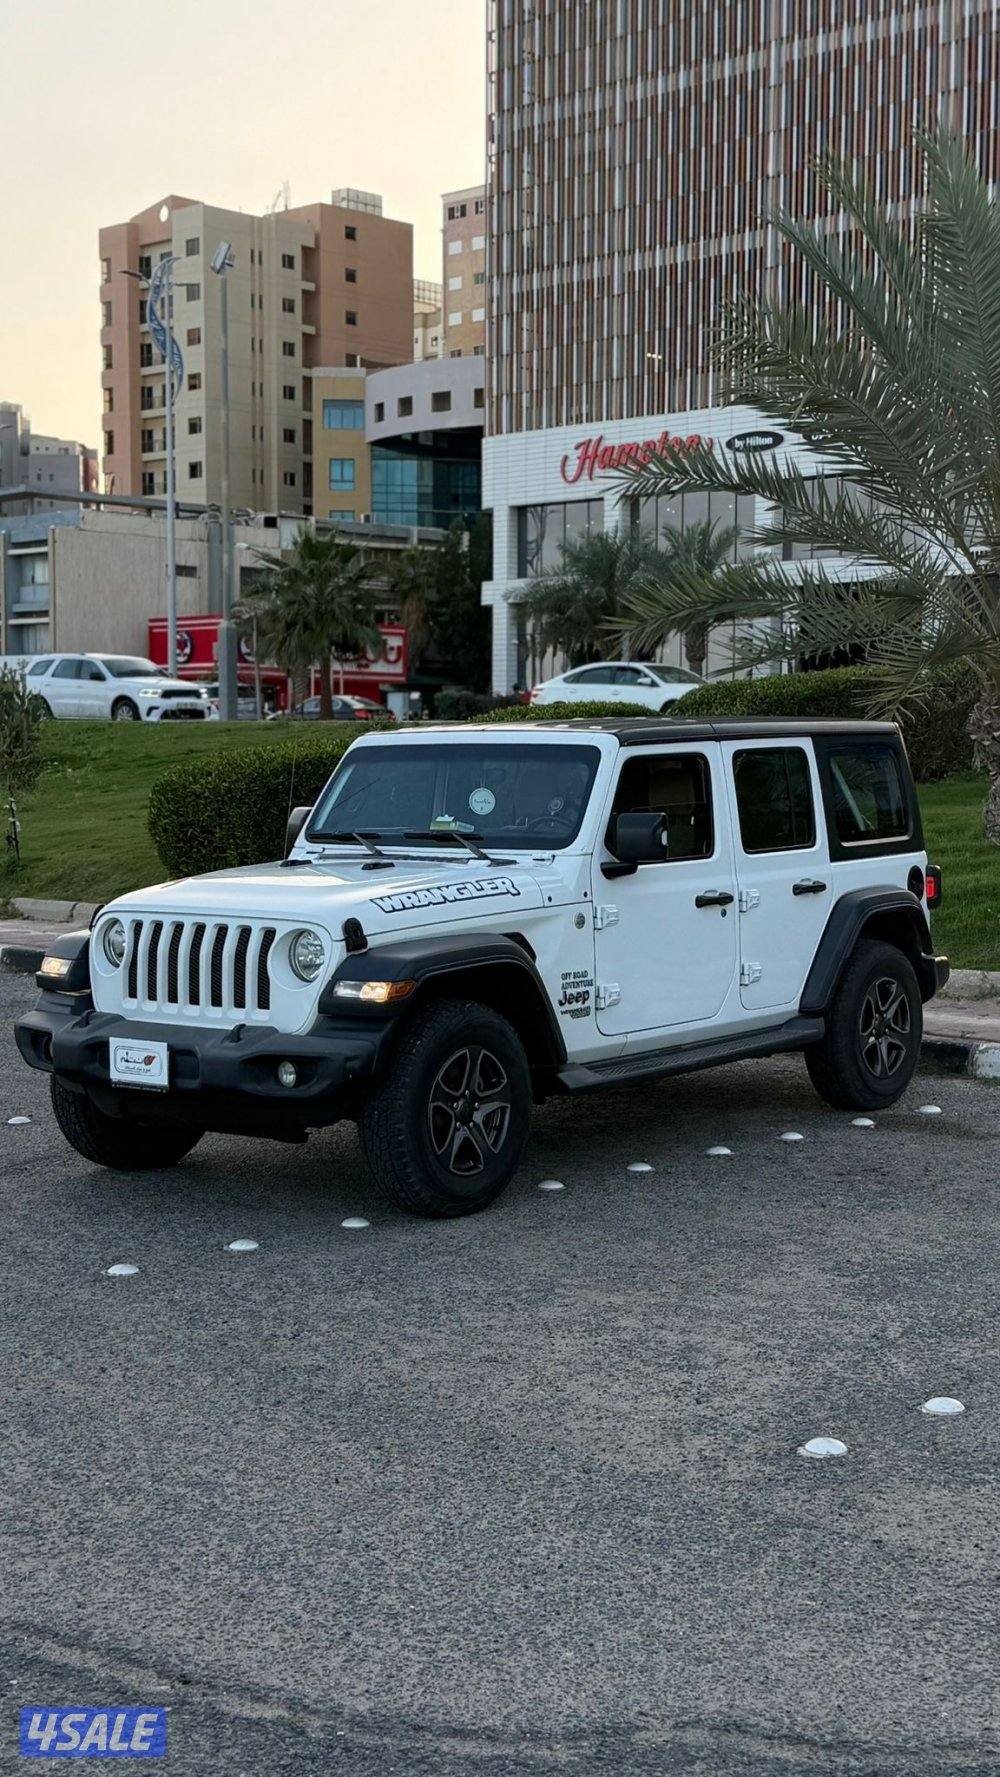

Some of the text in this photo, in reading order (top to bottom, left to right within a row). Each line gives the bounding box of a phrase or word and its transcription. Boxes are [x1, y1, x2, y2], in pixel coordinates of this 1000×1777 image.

[734, 435, 773, 449] by Hilton
[369, 876, 521, 914] WRANGLER
[573, 970, 589, 979] ROAD
[558, 990, 590, 1007] Jeep
